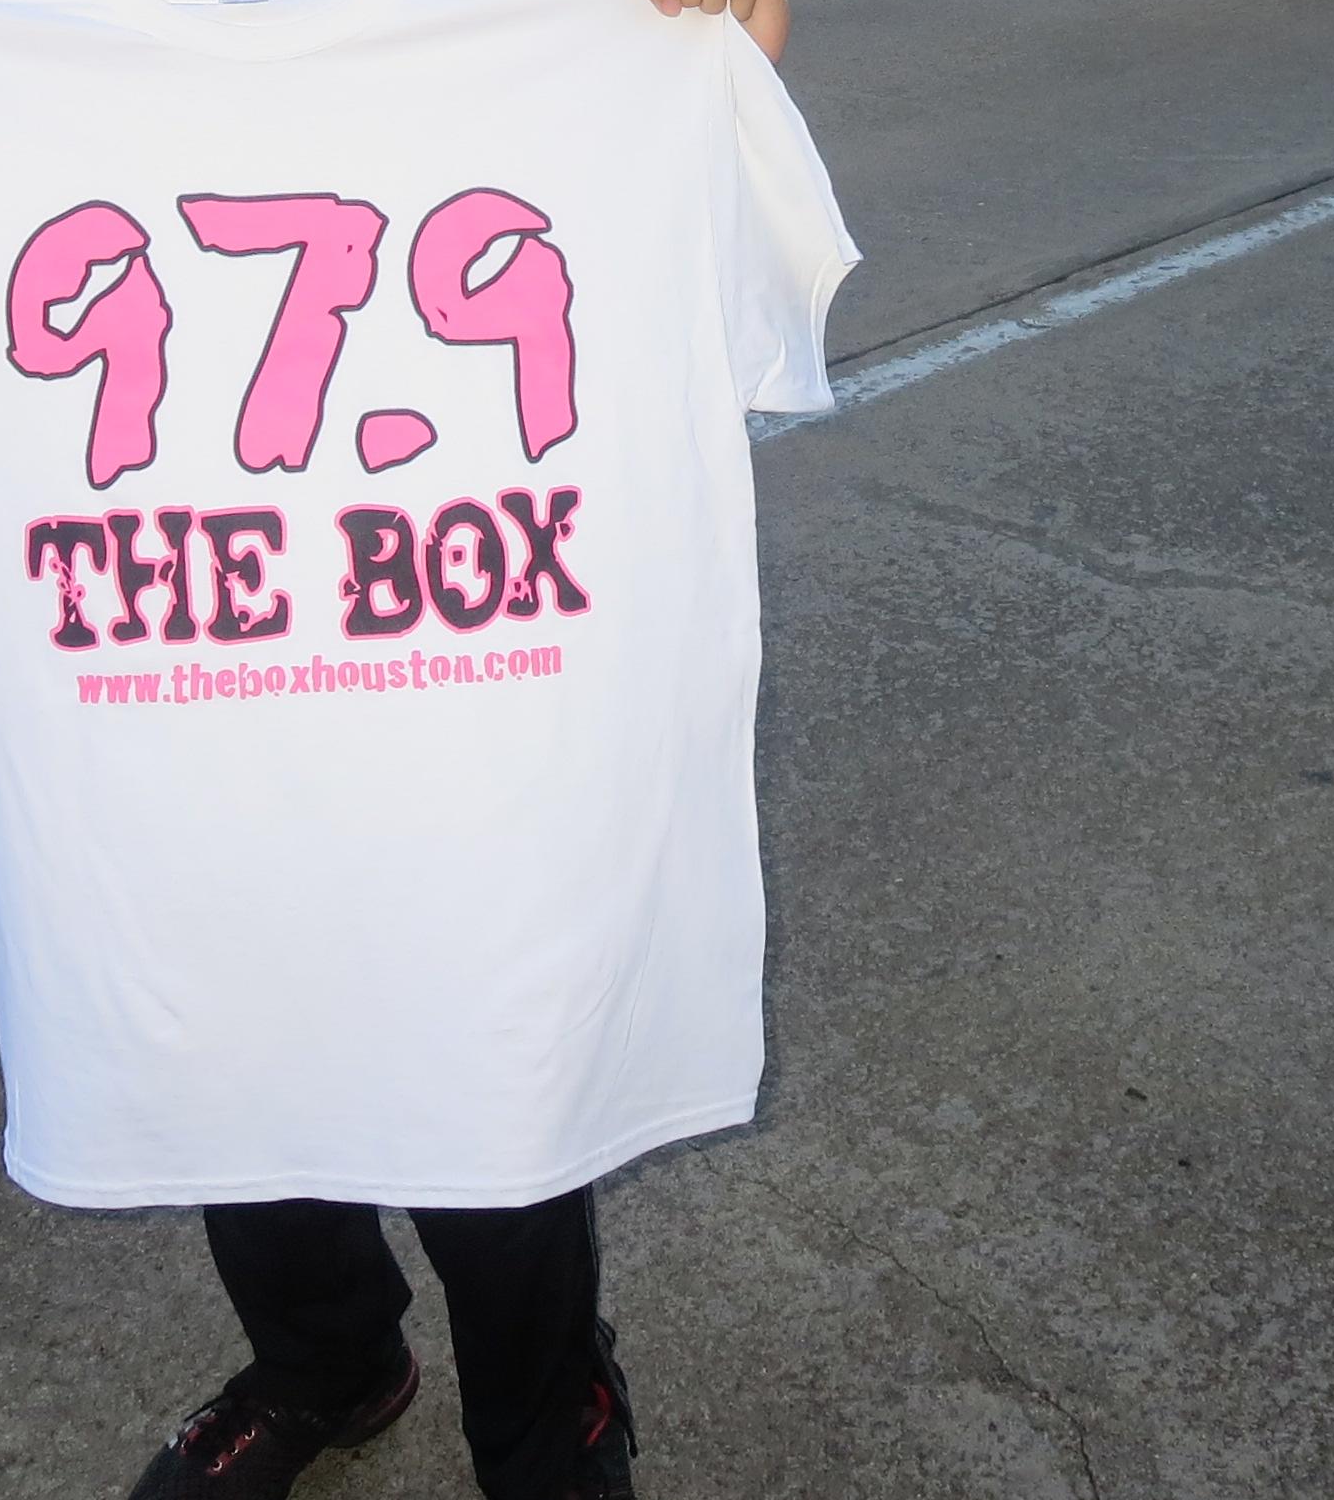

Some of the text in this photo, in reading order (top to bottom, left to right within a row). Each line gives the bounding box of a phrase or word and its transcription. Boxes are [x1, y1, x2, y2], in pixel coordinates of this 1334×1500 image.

[5, 187, 579, 490] 97.9
[24, 486, 592, 652] THE BOX
[78, 645, 563, 705] www.theboxhouston.com
